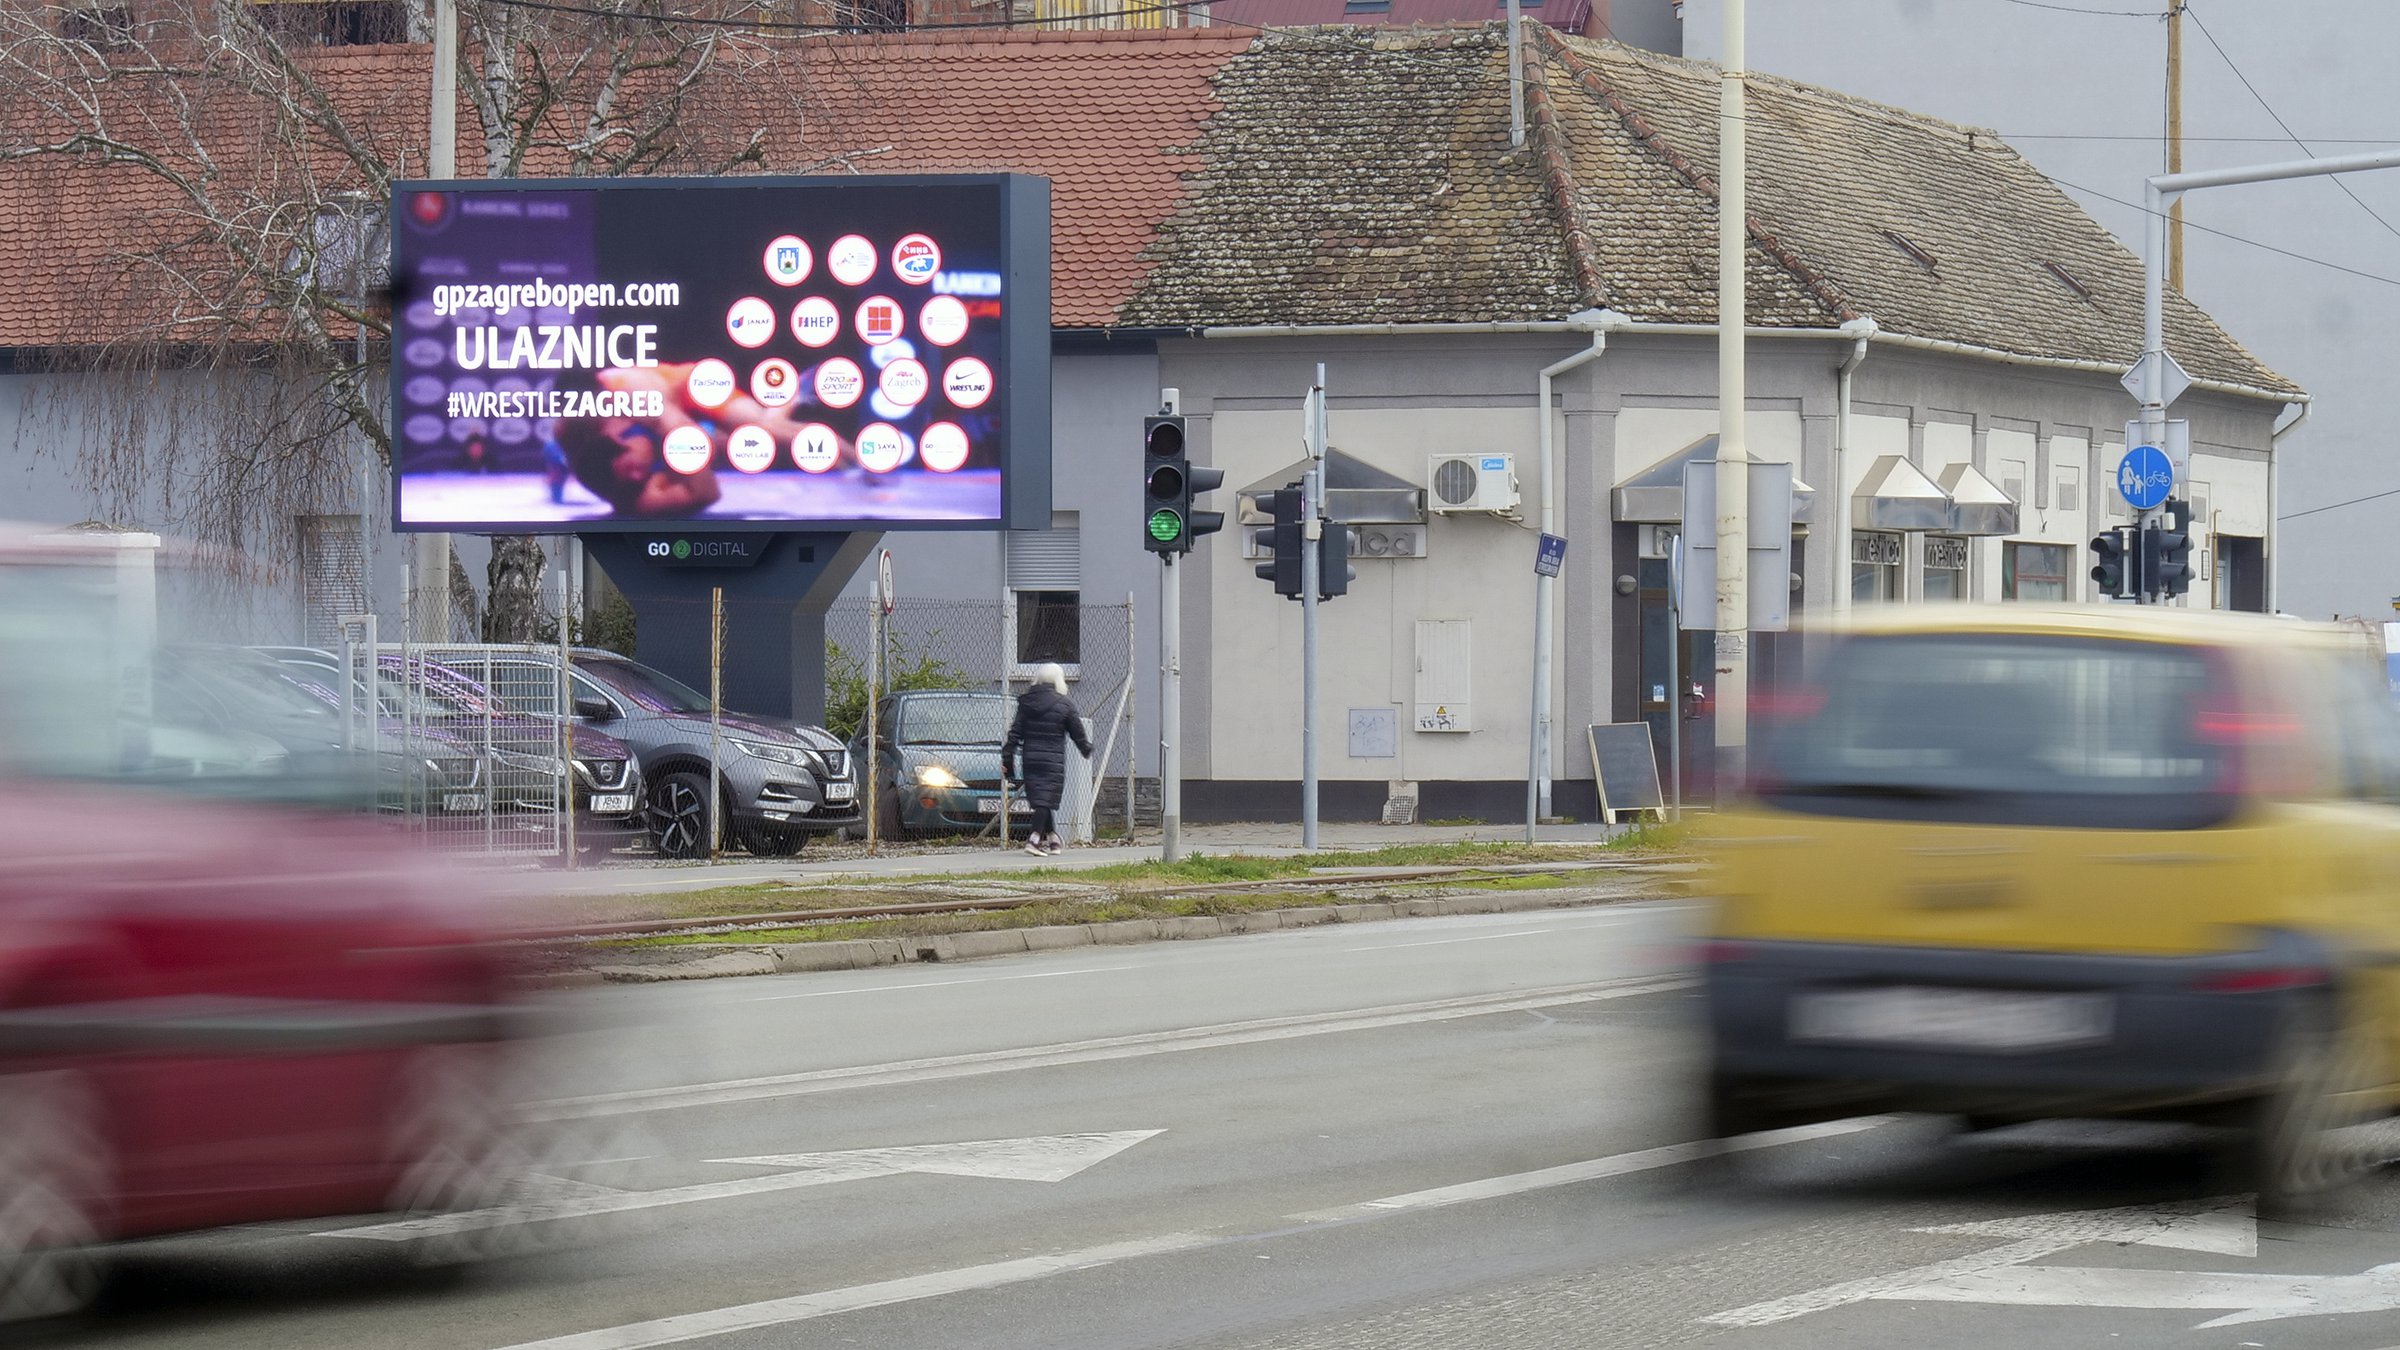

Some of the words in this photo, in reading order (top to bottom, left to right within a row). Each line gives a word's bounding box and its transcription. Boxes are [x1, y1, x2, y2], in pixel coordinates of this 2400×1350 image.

[433, 277, 680, 316] gpzagrebopen.com
[810, 316, 834, 328] HEP
[456, 325, 659, 369] ULAZNICE
[887, 376, 921, 389] Zagreb
[447, 391, 665, 418] #WRESTLEZAGREB
[647, 542, 670, 556] GO
[693, 542, 750, 556] DIGITAL
